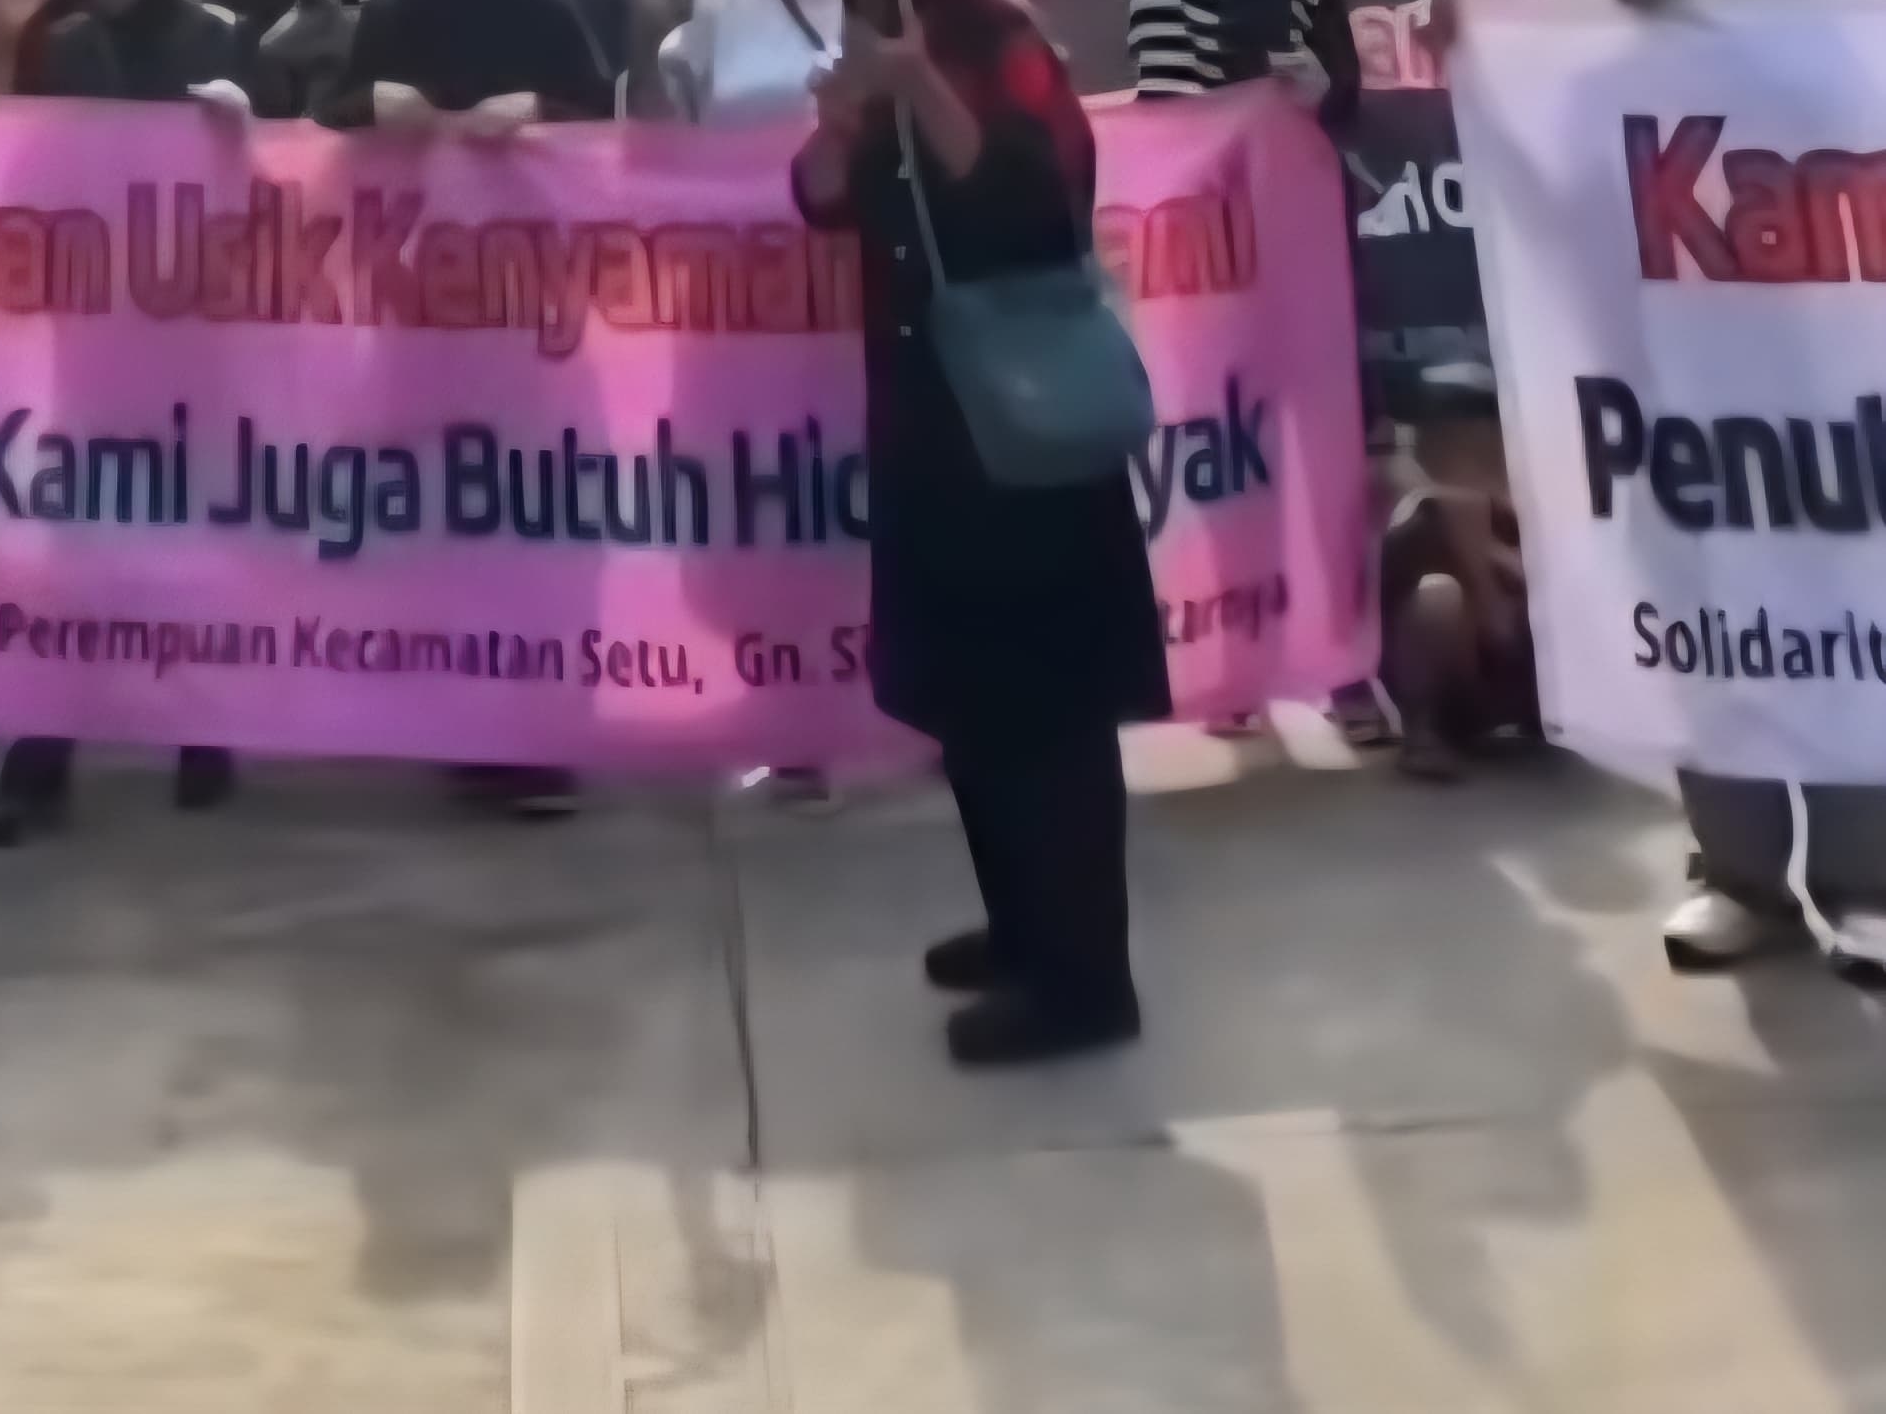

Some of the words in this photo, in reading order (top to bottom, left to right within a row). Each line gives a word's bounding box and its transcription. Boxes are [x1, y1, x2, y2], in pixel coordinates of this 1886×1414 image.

[126, 180, 342, 326] Usik
[207, 415, 422, 560] Juga
[442, 418, 709, 548] Butuh
[292, 612, 566, 684] Kecamatan
